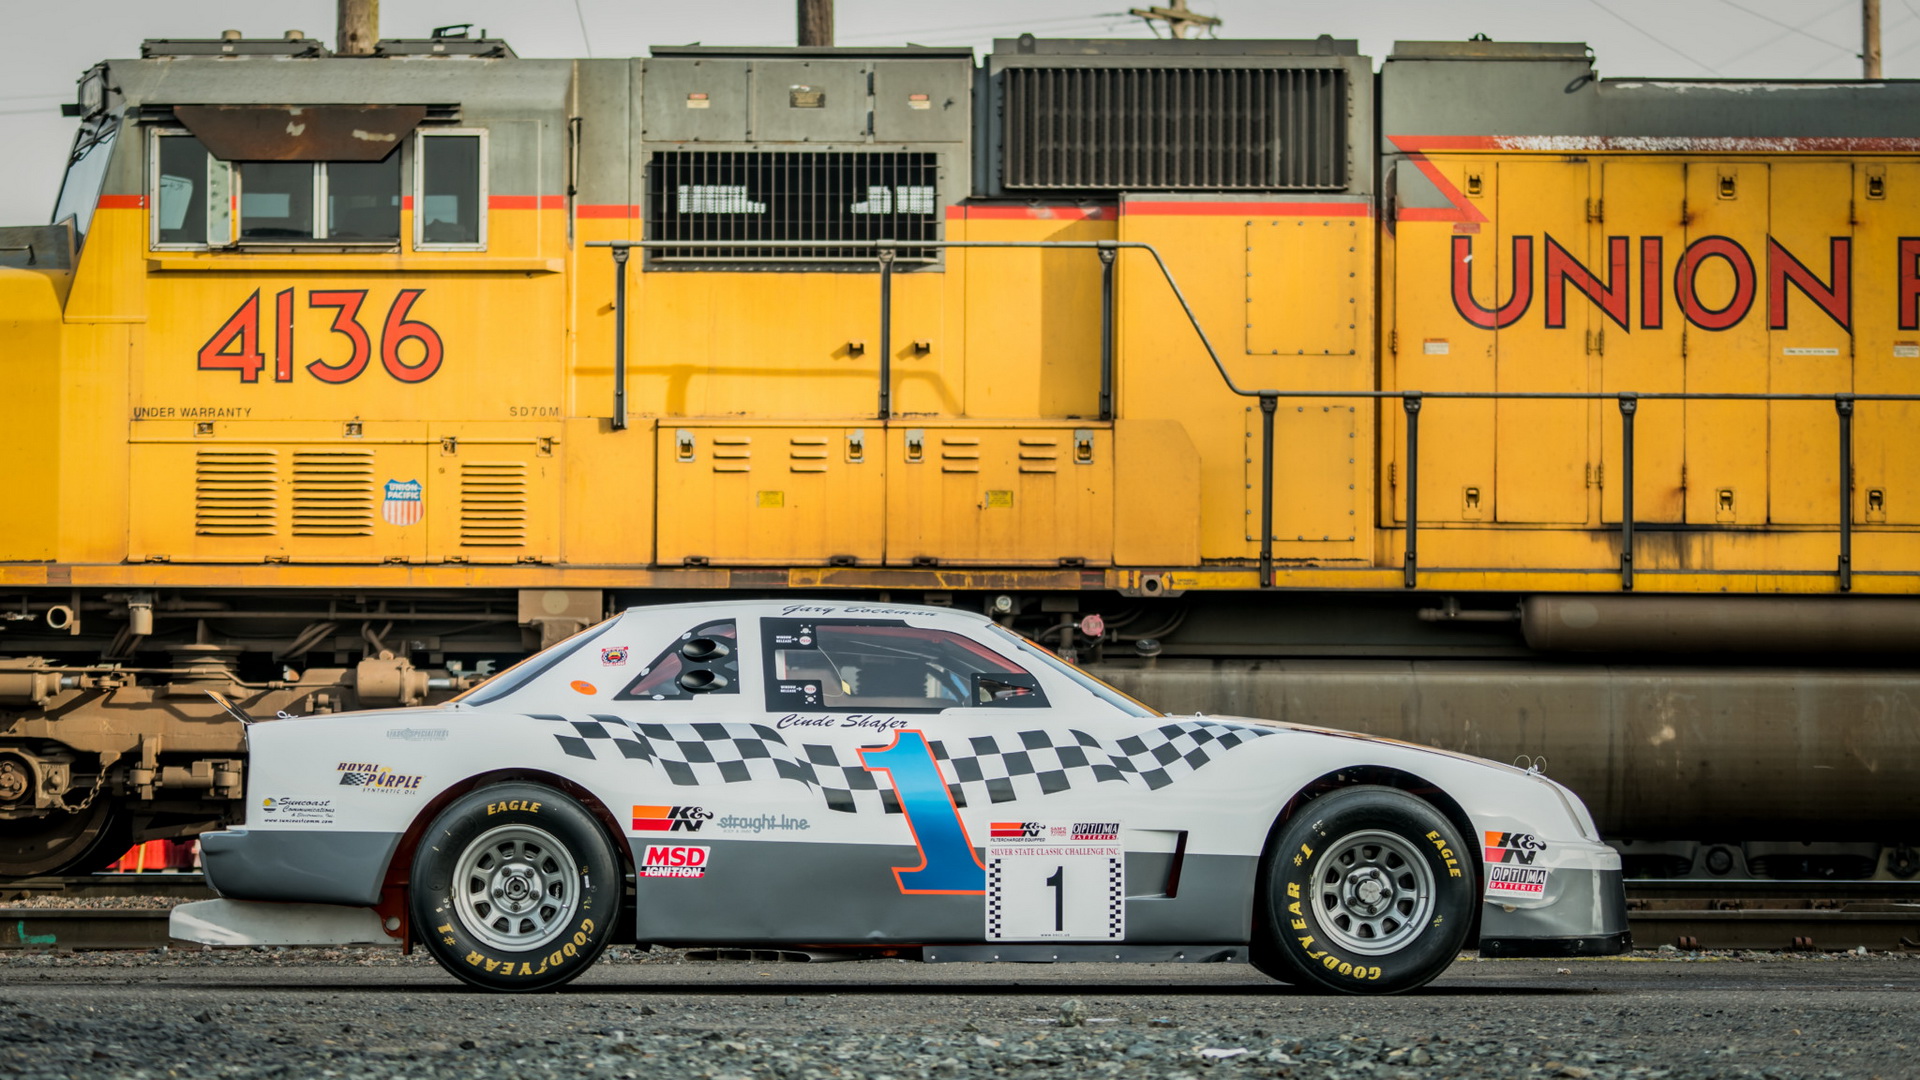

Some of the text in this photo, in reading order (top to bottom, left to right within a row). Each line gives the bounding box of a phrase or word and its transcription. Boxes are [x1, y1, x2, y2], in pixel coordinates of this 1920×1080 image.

[1450, 231, 1852, 334] UNION
[197, 286, 444, 384] 4136
[133, 407, 252, 418] UNDER WARRANTY
[509, 406, 560, 417] SD70M
[388, 483, 418, 491] UNION
[387, 491, 420, 500] PACIFIC
[782, 604, 836, 616] Gary
[776, 713, 909, 733] Cinde Shafer
[336, 762, 379, 772] ROYAL
[278, 797, 331, 807] Suncoast
[282, 805, 335, 813] Communications
[487, 800, 543, 816] EAGLE
[856, 729, 986, 895] 1
[717, 814, 811, 833] straight line
[1072, 823, 1119, 835] OPTIMA
[646, 847, 706, 867] MSD
[990, 848, 1013, 856] SILVER
[1014, 848, 1035, 856] STATE
[1036, 848, 1064, 856] CLASSIC
[1065, 848, 1104, 856] CHALLENGE
[1426, 830, 1462, 878] EAGLE
[645, 867, 702, 878] IGNITION
[1491, 866, 1546, 885] OPTIMA
[1490, 881, 1543, 893] BATTERIES
[1046, 866, 1063, 932] 1
[1287, 843, 1382, 980] GOODYEAR #1
[437, 918, 594, 976] GOODYEAR #1
